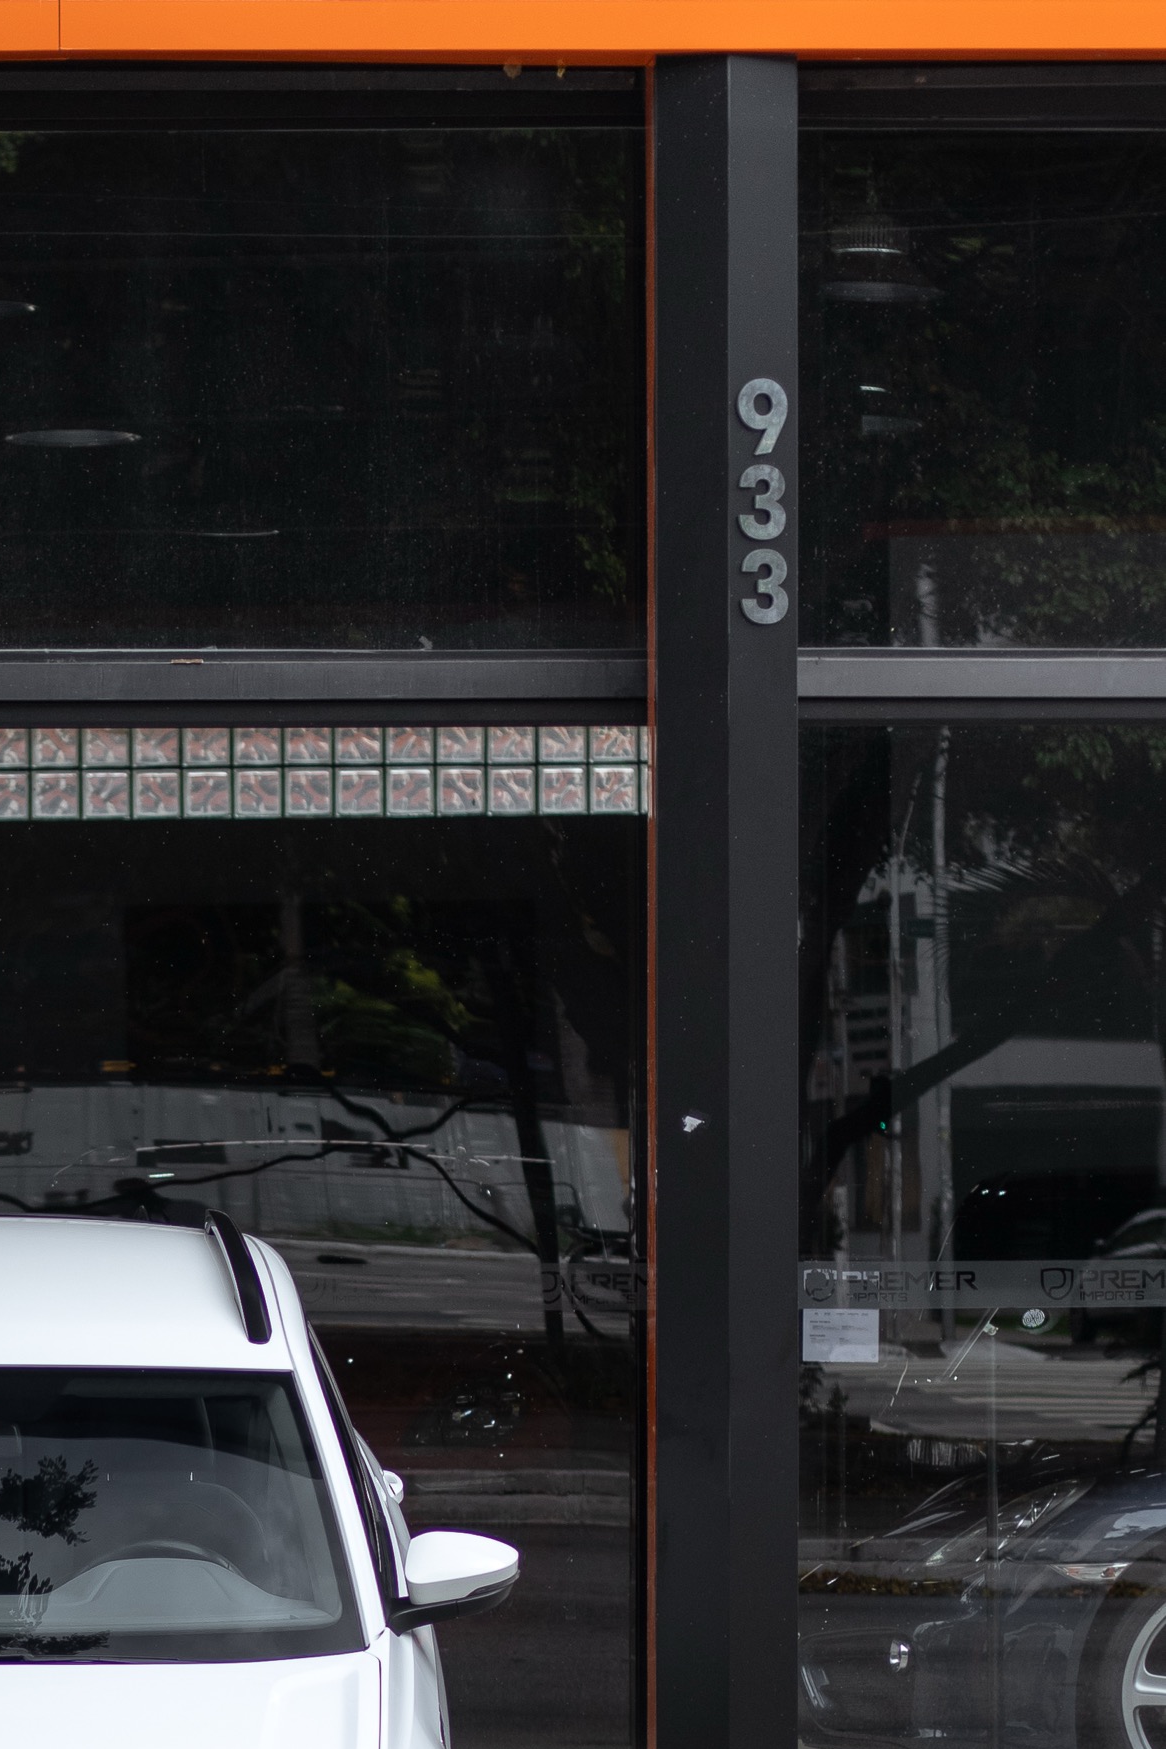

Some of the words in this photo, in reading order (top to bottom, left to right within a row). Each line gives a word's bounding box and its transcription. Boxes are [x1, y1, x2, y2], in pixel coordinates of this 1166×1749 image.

[737, 377, 789, 624] 933
[842, 1270, 979, 1291] PREMIER
[1080, 1290, 1145, 1301] IMPORTS
